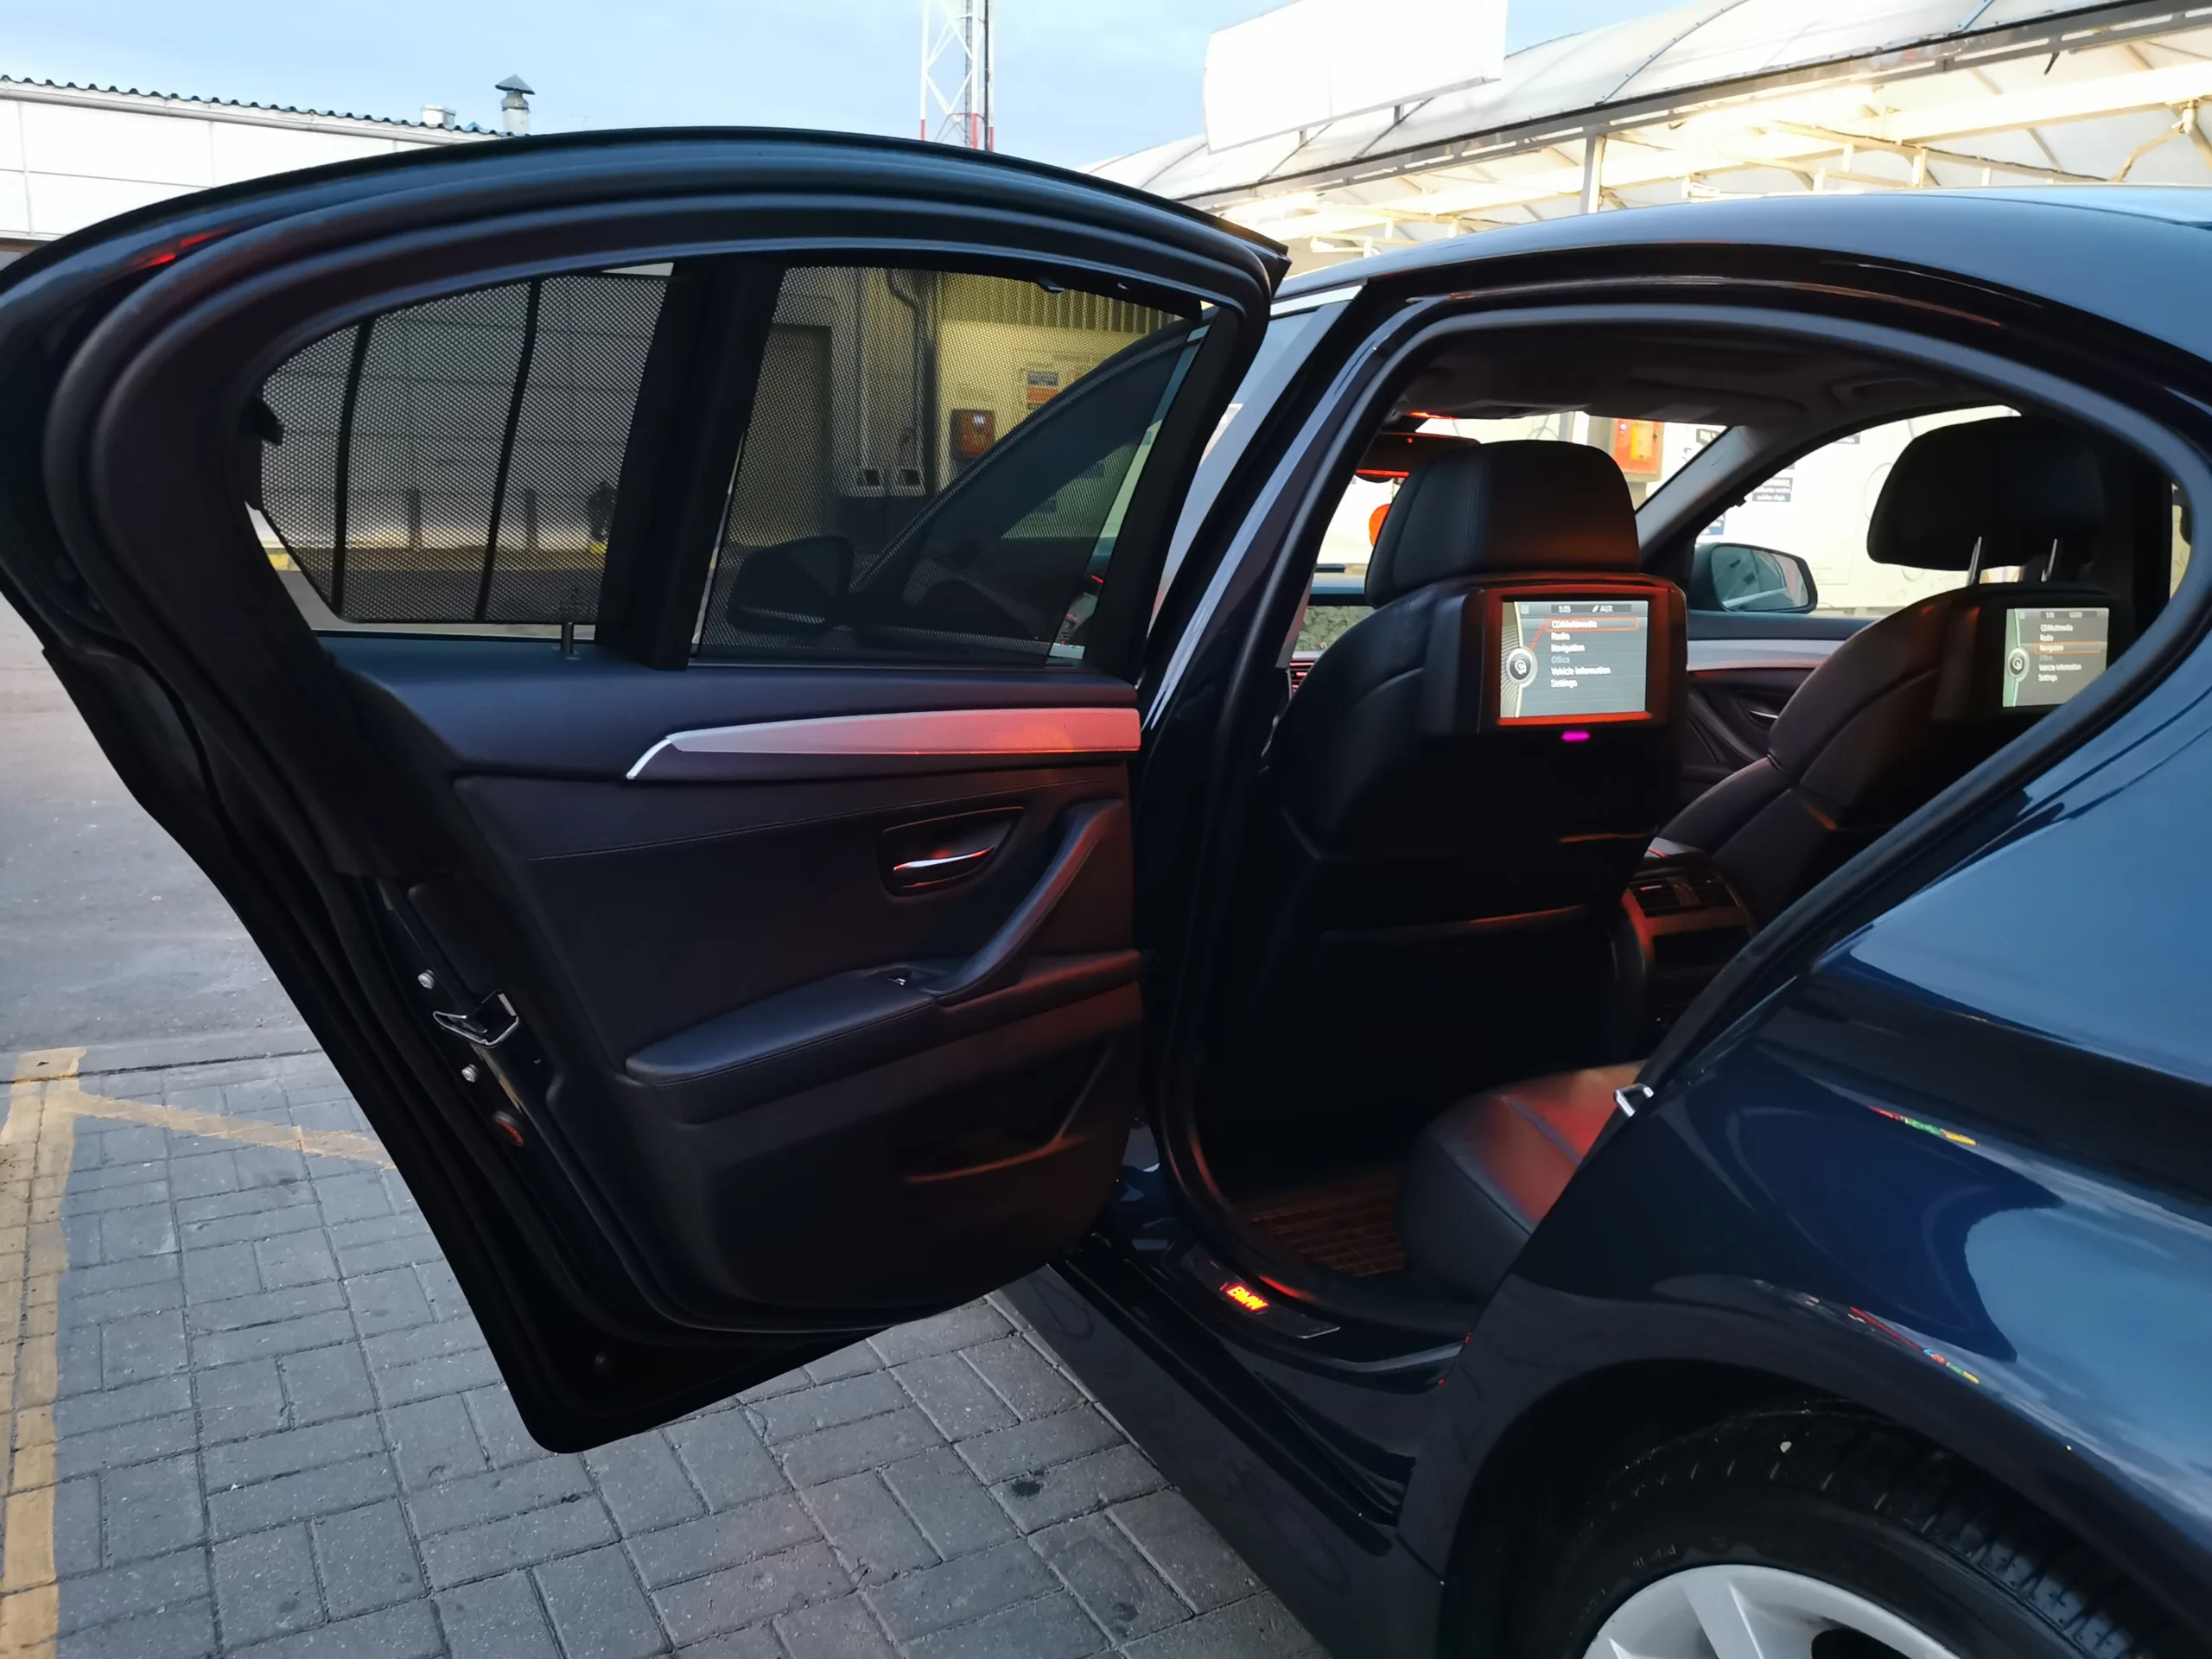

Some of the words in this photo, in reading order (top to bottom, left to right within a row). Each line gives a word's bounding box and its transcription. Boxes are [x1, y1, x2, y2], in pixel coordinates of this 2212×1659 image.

[1550, 632, 1571, 641] Radio
[1550, 643, 1586, 654] Navigation
[1550, 666, 1574, 676] Vehicle
[1550, 678, 1578, 689] Settings
